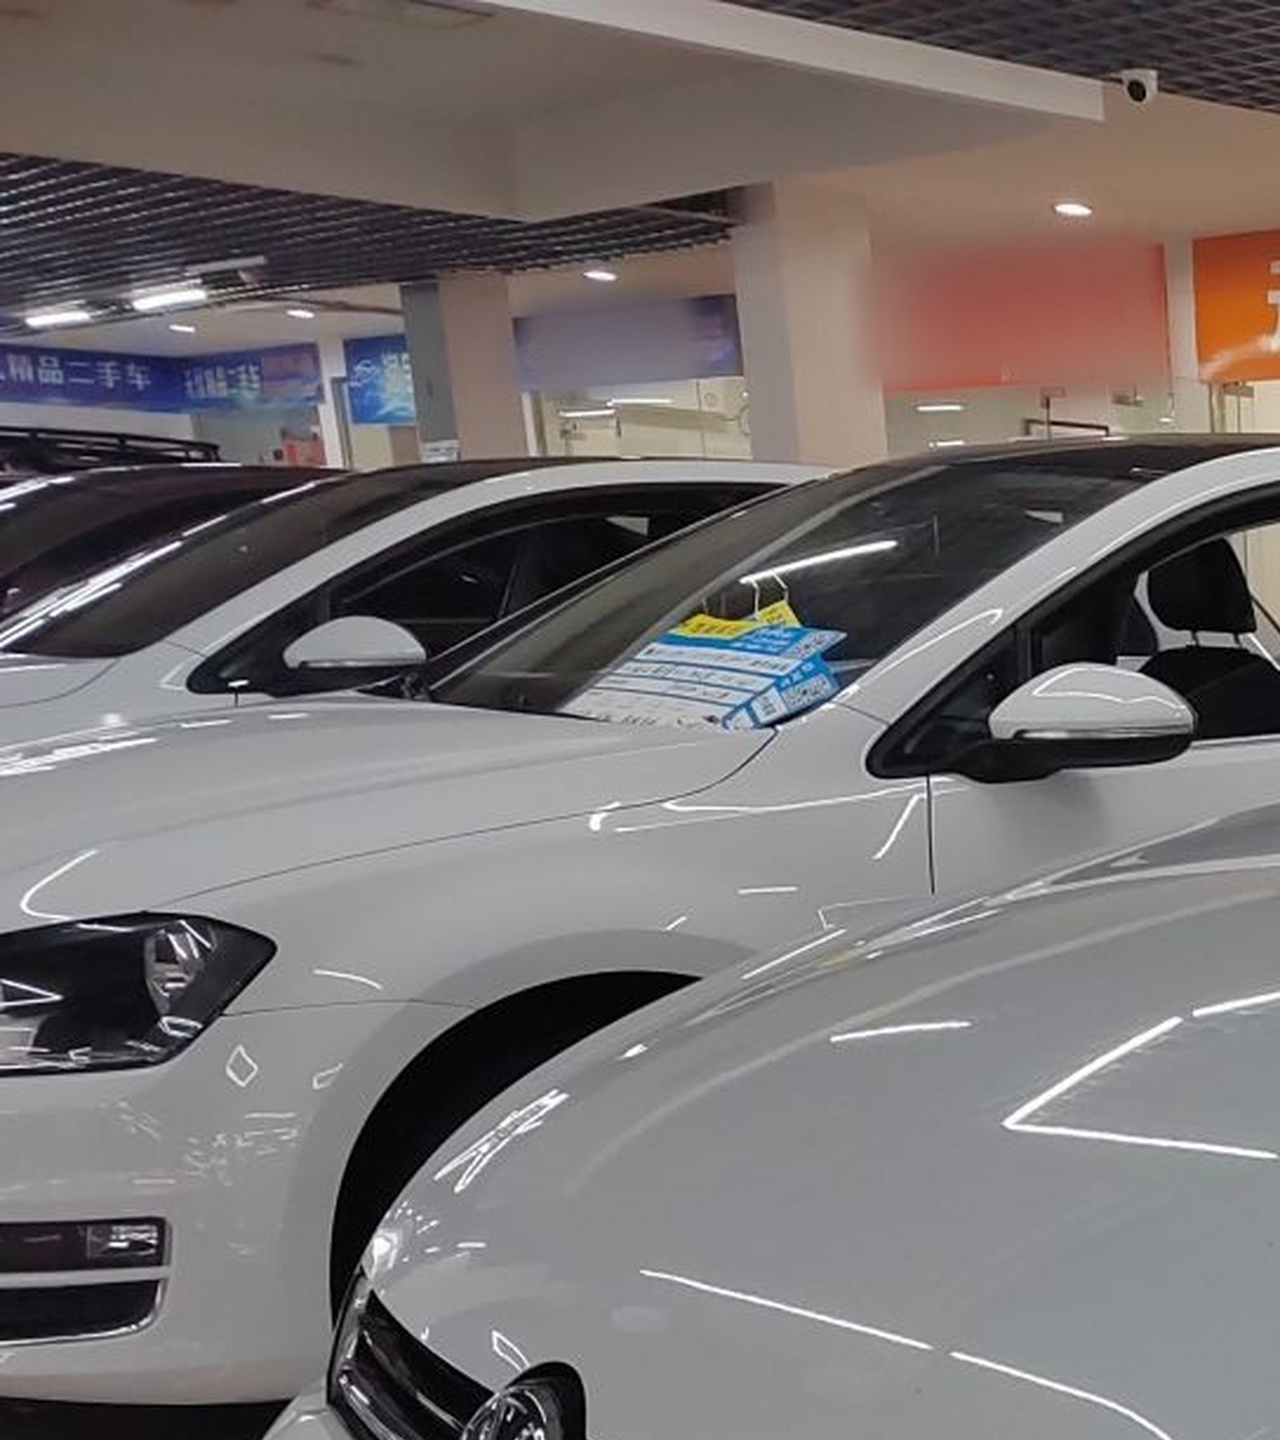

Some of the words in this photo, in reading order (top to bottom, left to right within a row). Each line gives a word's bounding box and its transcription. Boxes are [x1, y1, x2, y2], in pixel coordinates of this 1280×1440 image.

[0, 355, 151, 391] 精品二手车
